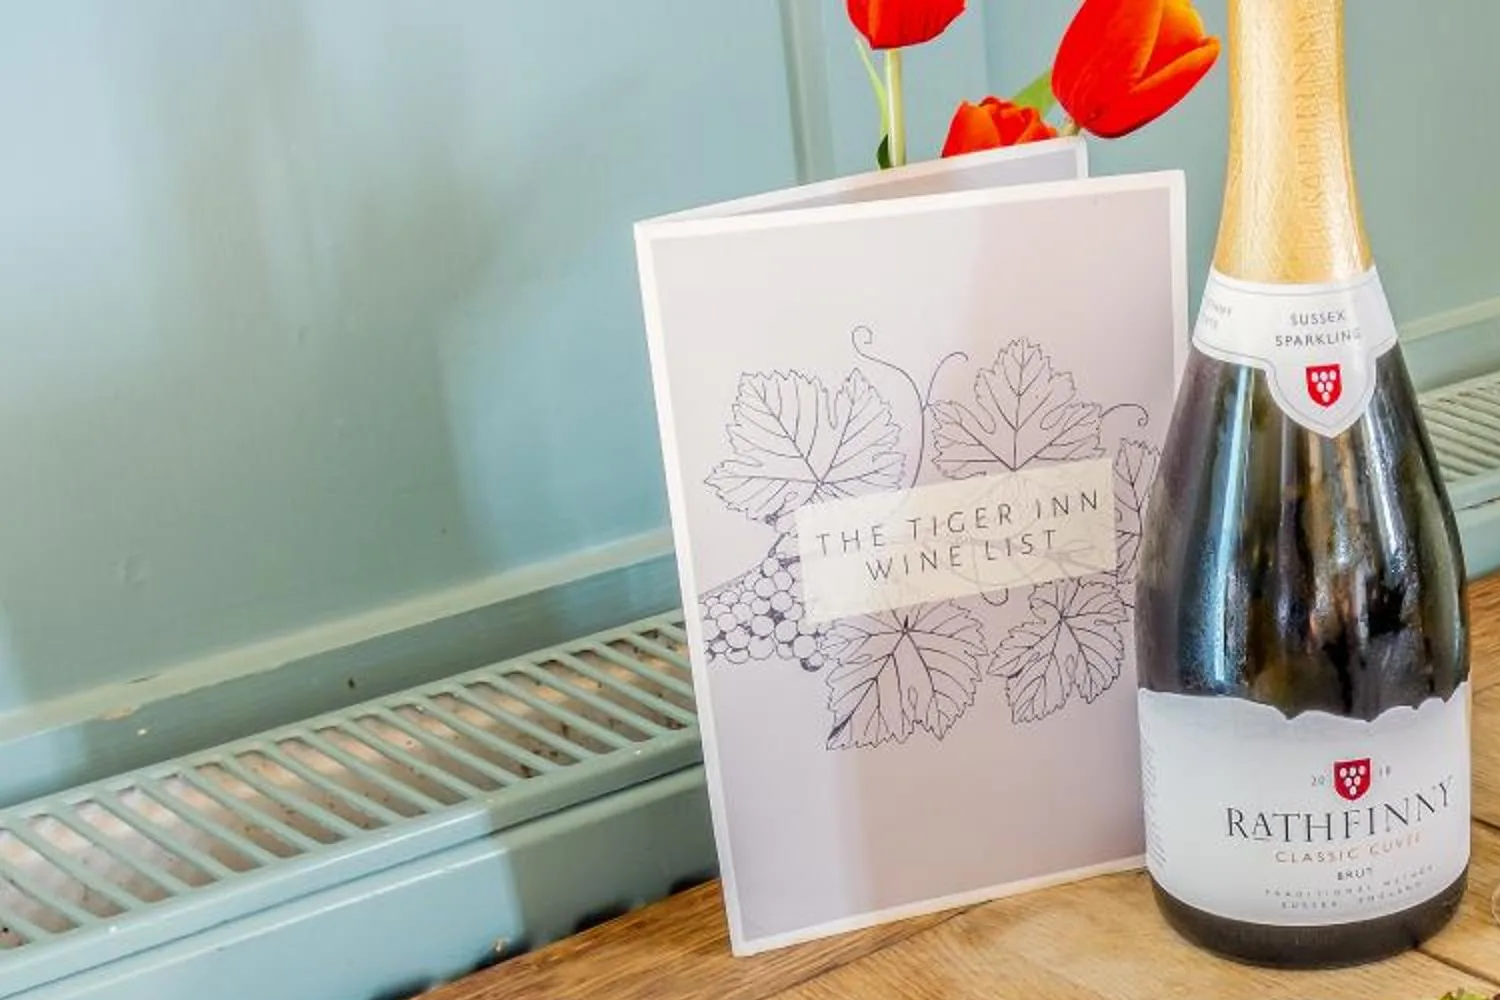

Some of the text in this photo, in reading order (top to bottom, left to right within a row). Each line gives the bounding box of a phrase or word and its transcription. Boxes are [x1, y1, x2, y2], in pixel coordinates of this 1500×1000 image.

[1290, 310, 1346, 326] SUSSEX
[1275, 328, 1361, 347] SPARKLING
[816, 490, 1098, 556] THE TIGER INN
[865, 530, 1057, 581] WINE LIST
[1226, 775, 1453, 843] RATHFINNY
[1275, 847, 1358, 864] CLASSIC
